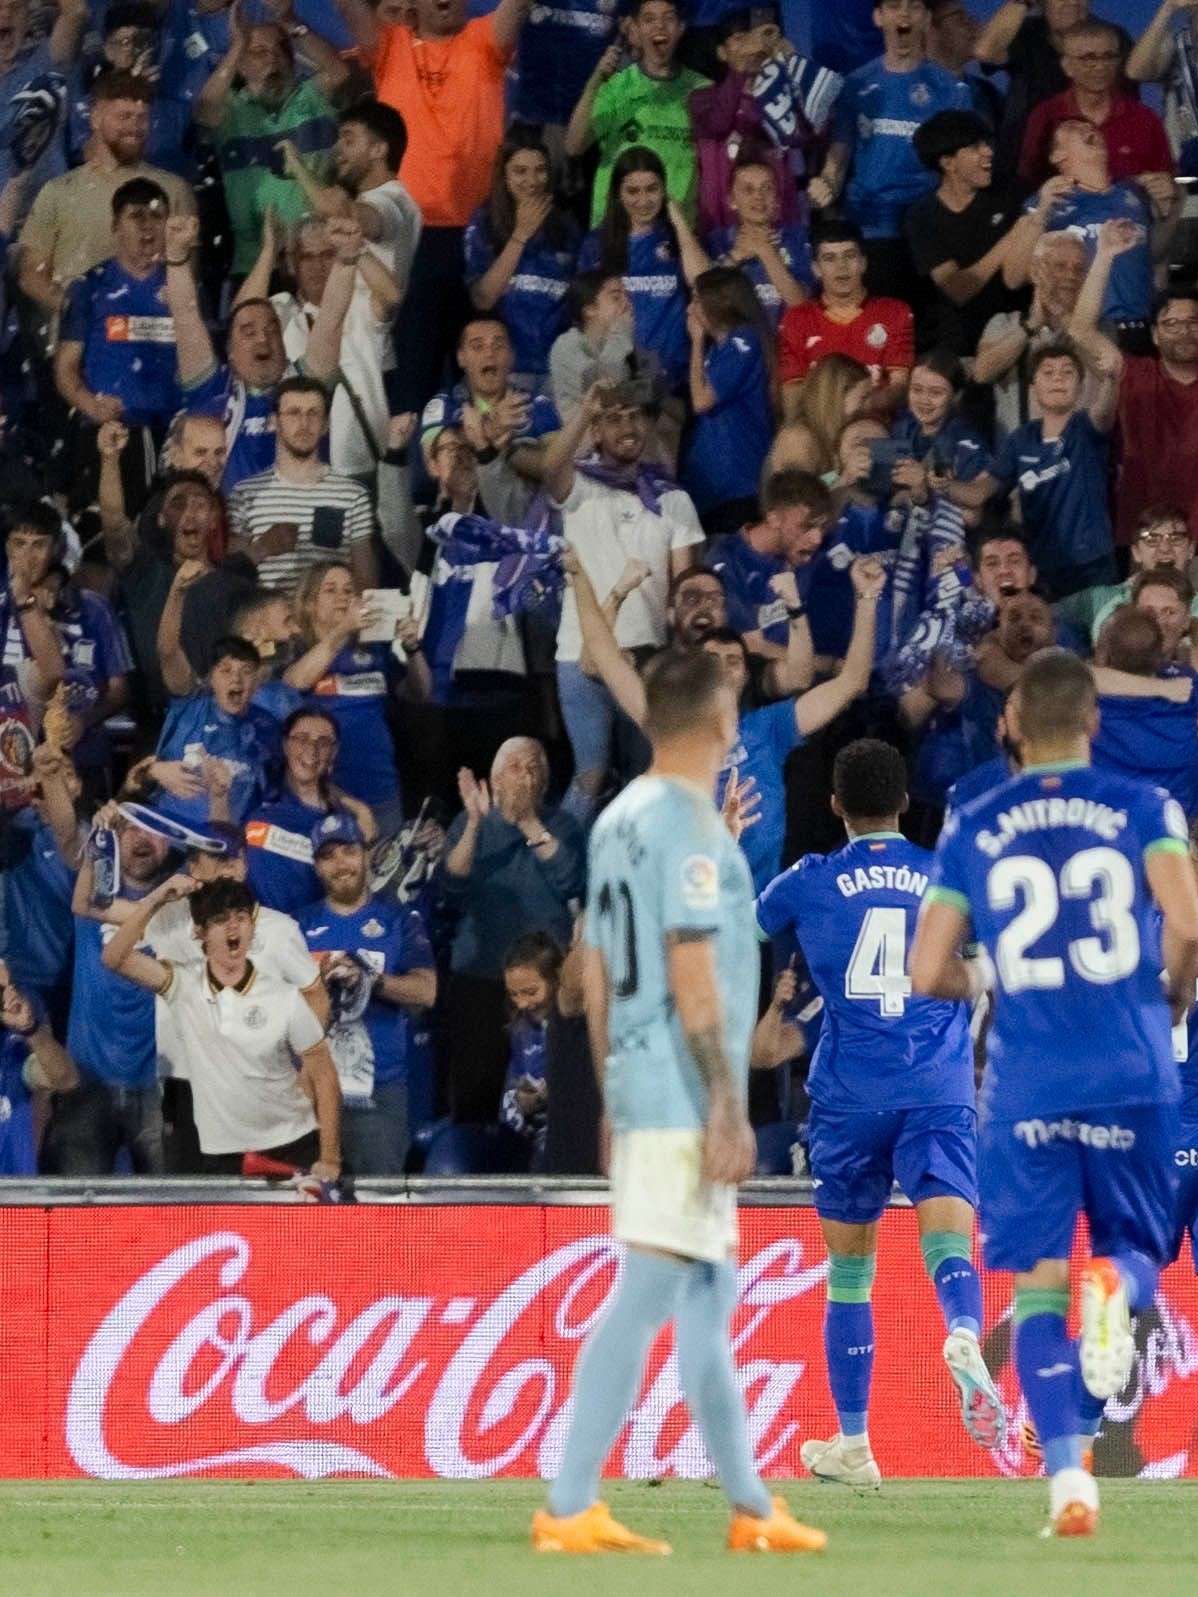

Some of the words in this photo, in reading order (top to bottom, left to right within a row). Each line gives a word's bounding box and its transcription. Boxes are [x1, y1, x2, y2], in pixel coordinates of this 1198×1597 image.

[836, 865, 929, 898] GASTÓN
[986, 846, 1141, 996] 23
[845, 907, 912, 1018] 4
